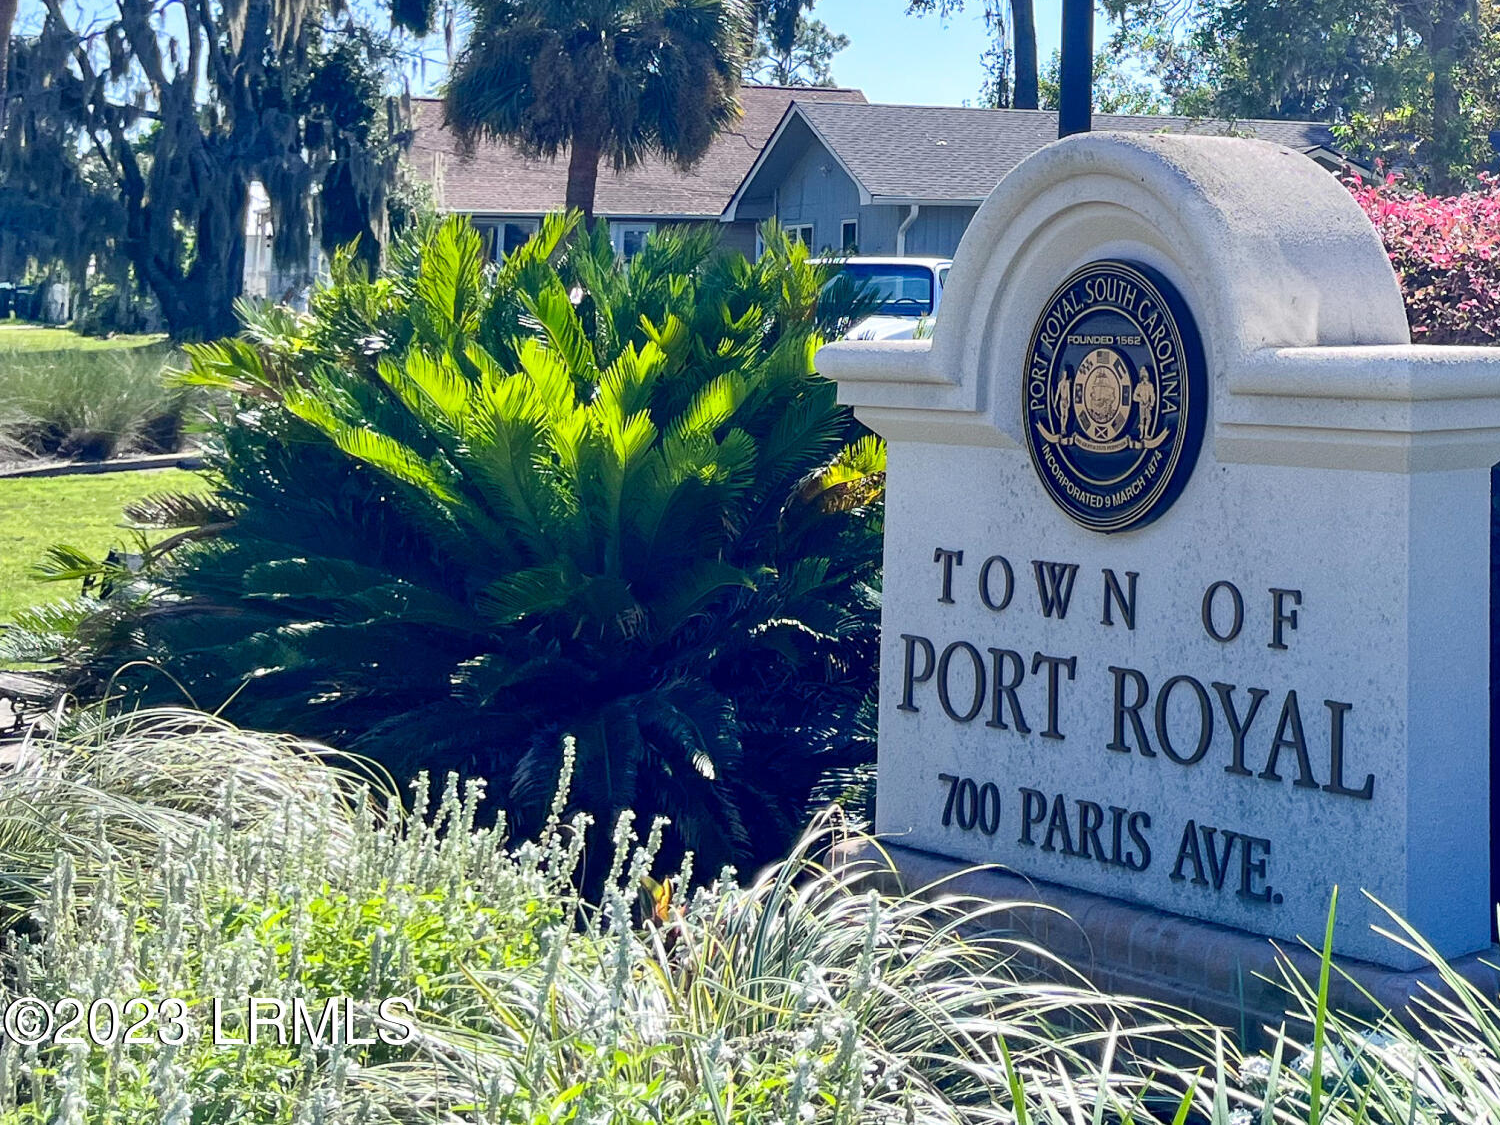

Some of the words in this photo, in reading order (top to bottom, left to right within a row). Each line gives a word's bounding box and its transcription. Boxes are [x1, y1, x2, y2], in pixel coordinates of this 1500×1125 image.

[1030, 352, 1048, 411] PORT
[1085, 277, 1137, 311] SOUTH
[1137, 298, 1180, 415] CAROLINA
[1067, 335, 1114, 345] FOUNDED
[1115, 335, 1142, 346] 1562
[1041, 443, 1104, 508] INCORPORATED
[1104, 496, 1111, 508] 9
[1112, 476, 1146, 507] MARCH
[1144, 450, 1163, 479] 1874
[934, 548, 1140, 630] TOWN
[1202, 580, 1302, 649] OF
[896, 633, 1077, 740] PORT
[1106, 665, 1375, 800] ROYAL
[938, 773, 1000, 836] 700
[1017, 787, 1151, 872] PARIS
[1169, 819, 1284, 904] AVE.
